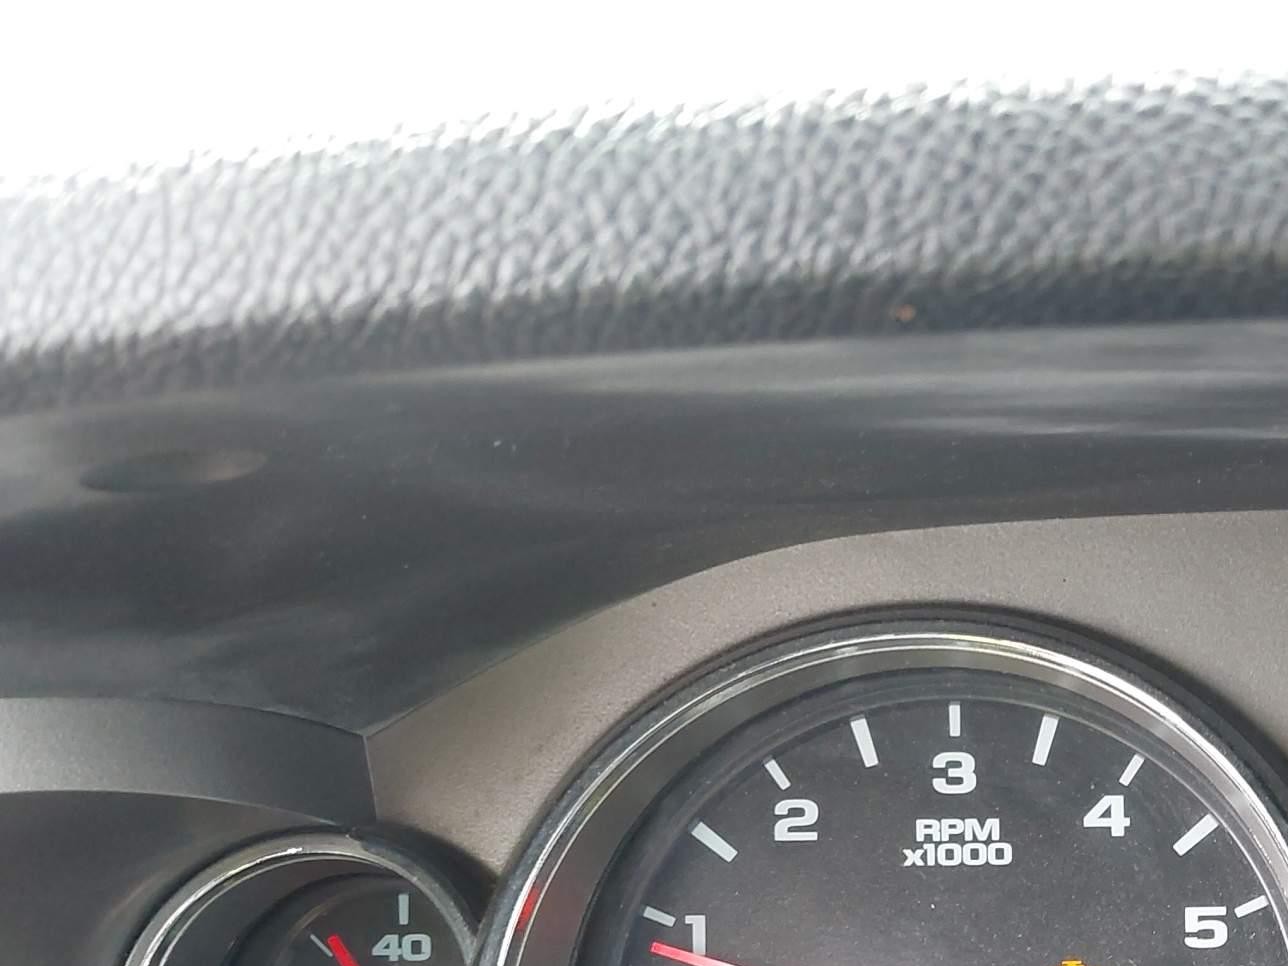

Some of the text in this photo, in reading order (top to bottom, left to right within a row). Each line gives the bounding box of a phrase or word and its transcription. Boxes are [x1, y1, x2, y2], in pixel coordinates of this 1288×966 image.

[932, 752, 977, 794] 3
[773, 799, 818, 841] 2
[915, 819, 1000, 841] RPM
[1083, 795, 1130, 837] 4
[903, 842, 1013, 866] x1000
[371, 934, 432, 962] 40
[684, 915, 706, 956] 1
[1183, 906, 1228, 949] 5
